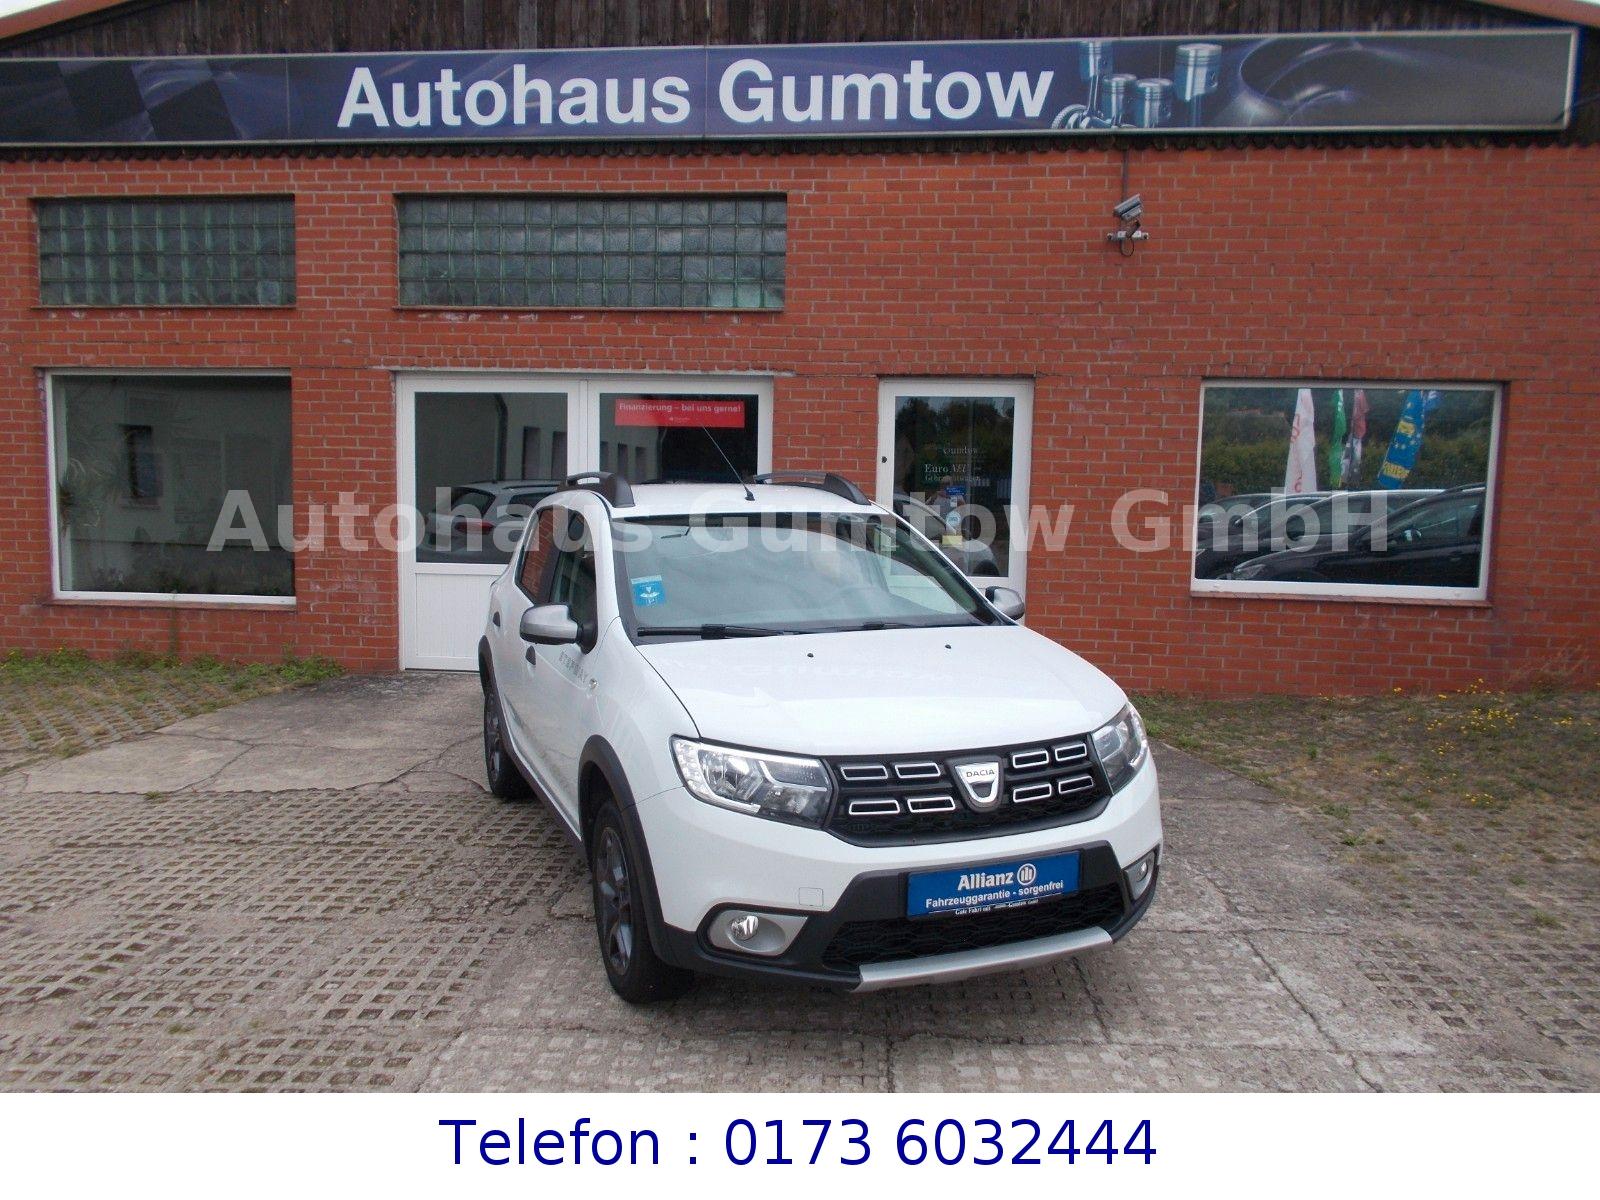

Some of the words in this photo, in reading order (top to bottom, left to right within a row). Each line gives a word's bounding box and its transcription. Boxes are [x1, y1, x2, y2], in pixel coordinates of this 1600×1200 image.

[336, 63, 691, 128] Autohaus
[718, 57, 1054, 123] Gumtow
[619, 402, 673, 413] Finanzierung
[681, 403, 695, 412] bei
[924, 463, 949, 473] Euro
[965, 769, 996, 779] DACIA
[957, 871, 1014, 891] Allianz
[925, 889, 1011, 909] Fahrzeuggarantie
[1018, 880, 1064, 896] sorgenfrei
